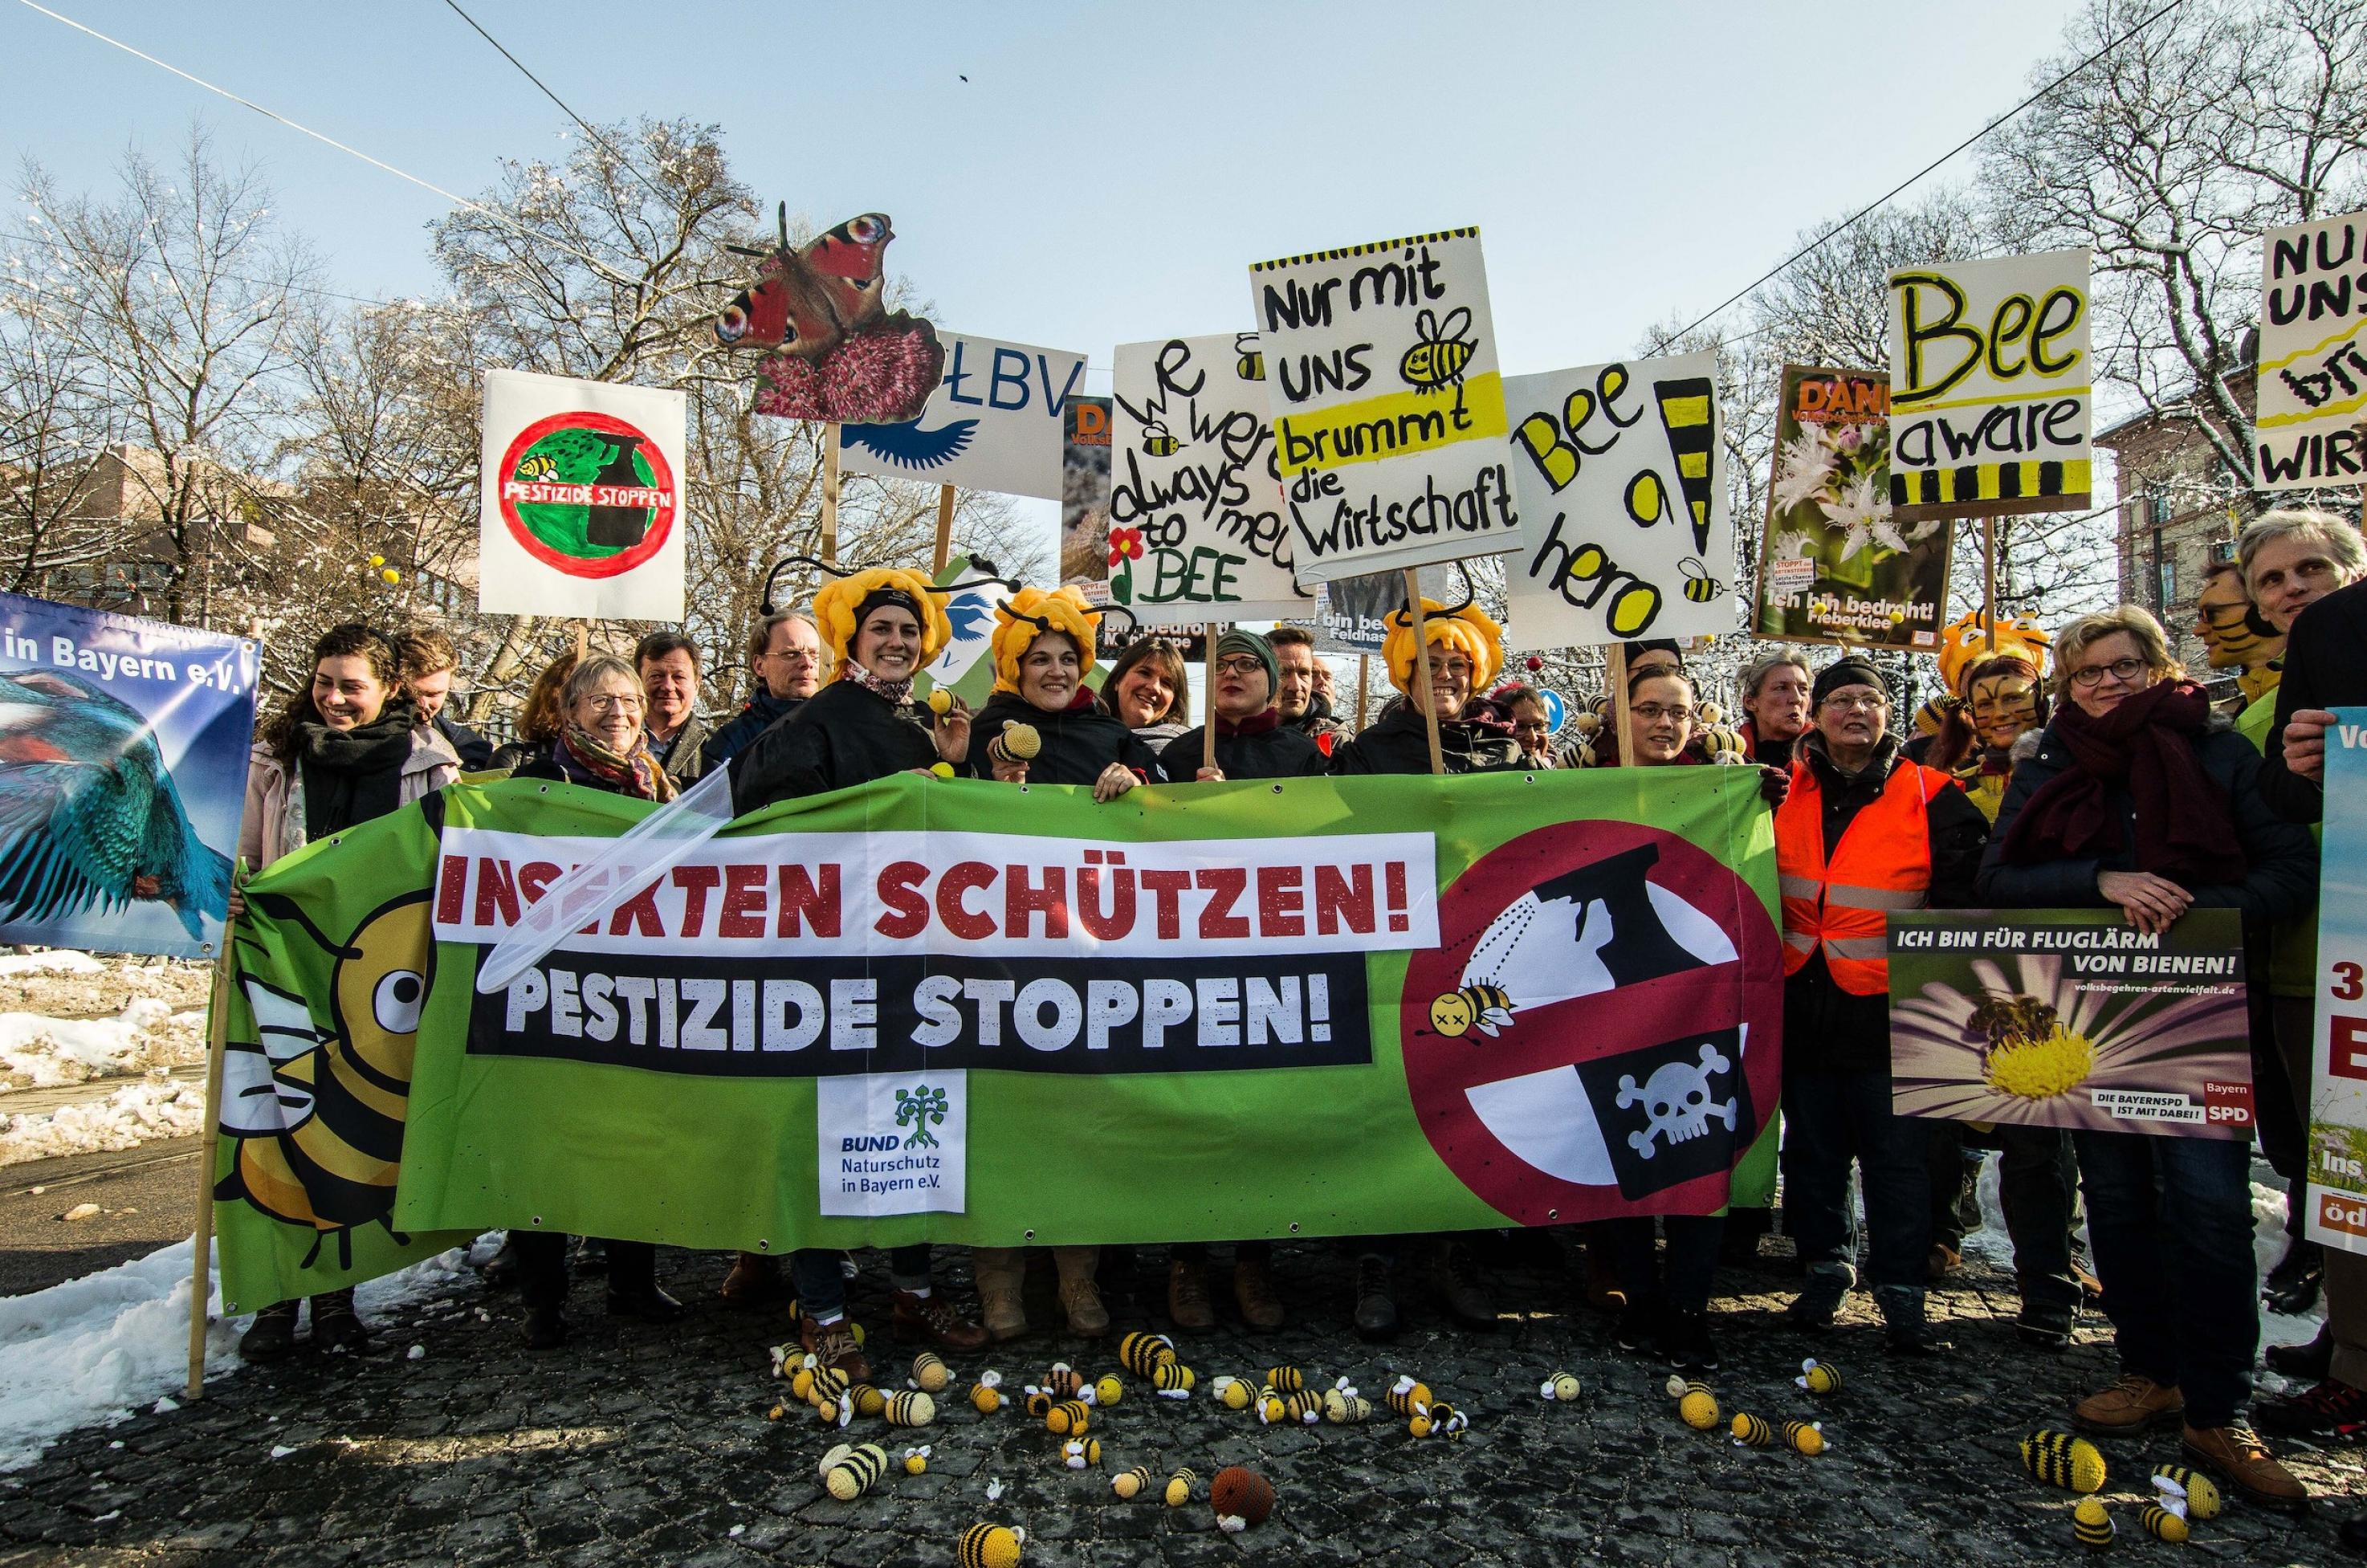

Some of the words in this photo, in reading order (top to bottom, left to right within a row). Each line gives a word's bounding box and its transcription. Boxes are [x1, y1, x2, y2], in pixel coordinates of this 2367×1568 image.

[2273, 224, 2367, 280] NU
[1264, 278, 1342, 333] Nur
[1350, 245, 1445, 312] mit
[1890, 271, 2085, 403] Bee
[945, 341, 1084, 417] LBV
[1280, 343, 1374, 403] UNS
[1078, 405, 1112, 434] D
[1282, 383, 1473, 466] brummt
[1510, 363, 1644, 495] Bee
[1791, 410, 1886, 426] Volksbegehren
[1896, 398, 2084, 466] aware
[2259, 430, 2367, 483] WIR
[503, 483, 593, 503] PESTIZIDE
[594, 488, 671, 507] STOPPEN
[1291, 466, 1345, 503] die
[1623, 469, 1674, 528] a
[1289, 463, 1518, 556] Wirtschaft
[1137, 514, 1187, 548] to
[1139, 546, 1247, 602] BEE
[1530, 511, 1661, 638] hero
[1767, 589, 1801, 608] Ich
[1323, 613, 1353, 629] bin
[1330, 627, 1387, 642] Feldhas
[5, 628, 39, 662] in
[52, 636, 176, 682] Bayern
[187, 660, 240, 695] e.V.
[437, 854, 841, 939] INSEKTEN
[874, 849, 1409, 940] SCHÜTZEN!
[1896, 931, 1933, 947] ICH
[1938, 931, 1978, 948] BIN
[1982, 927, 2026, 948] FÜR
[2031, 927, 2159, 949] FLUGLÄRM
[2073, 955, 2127, 972] VON
[2133, 955, 2236, 975] BIENEN!
[2075, 983, 2235, 996] volksbegehren-artenvielfalt.de
[506, 967, 878, 1052] PESTIZIDE
[910, 973, 1332, 1052] STOPPEN!
[2098, 1094, 2115, 1102] DIE
[2118, 1095, 2182, 1106] BAYERNSPD
[2207, 1083, 2247, 1094] Bayern
[2117, 1106, 2133, 1114] IST
[2136, 1106, 2155, 1116] MIT
[2209, 1106, 2248, 1122] SPD
[841, 1135, 899, 1152] BUND
[841, 1155, 940, 1173] Naturschutz
[2323, 1151, 2362, 1177] Ins
[842, 1179, 856, 1192] in
[861, 1178, 914, 1195] Bayern
[918, 1175, 940, 1189] e.V.
[2325, 1203, 2366, 1228] öd
